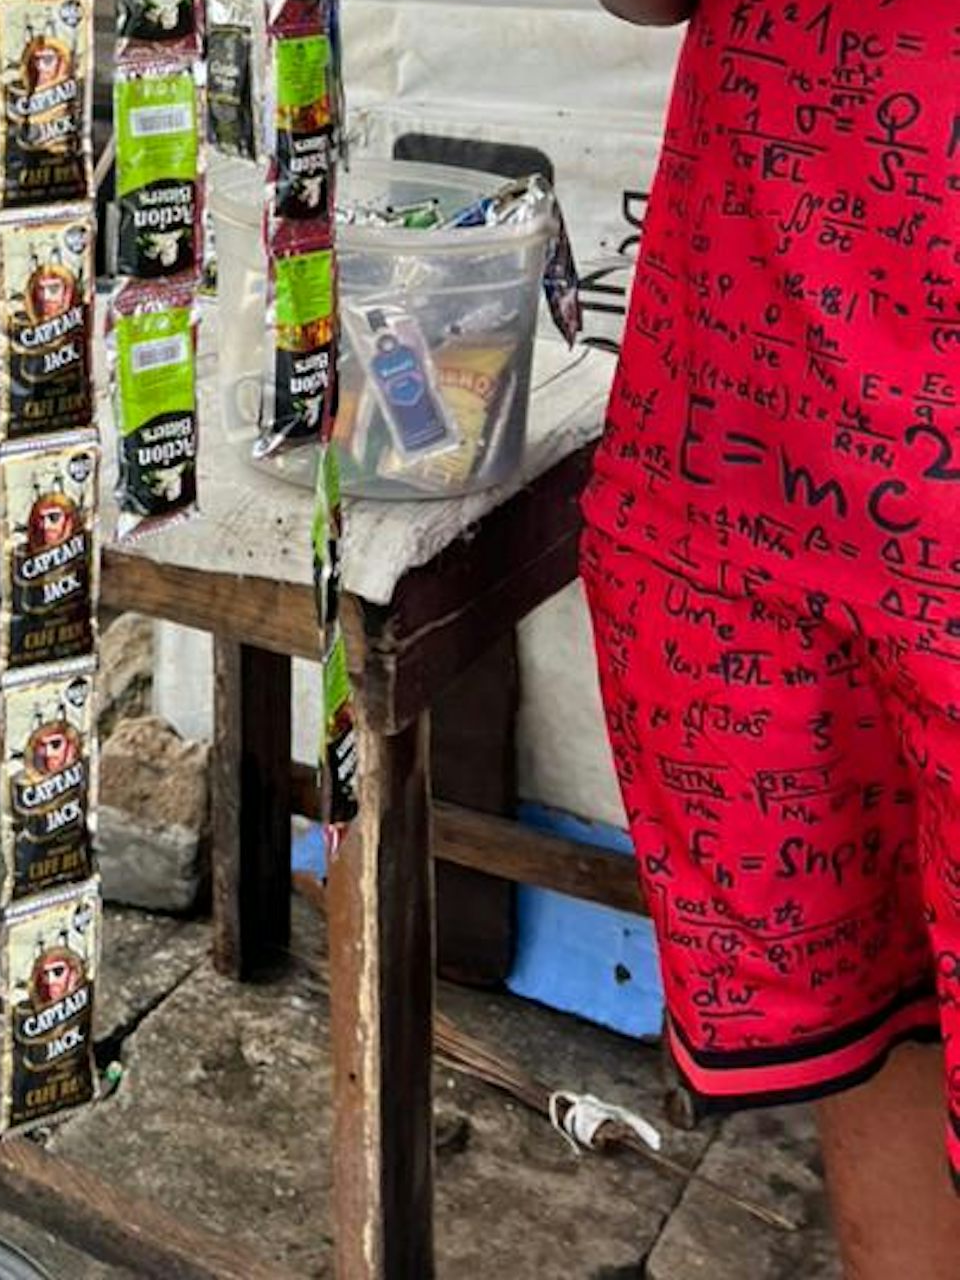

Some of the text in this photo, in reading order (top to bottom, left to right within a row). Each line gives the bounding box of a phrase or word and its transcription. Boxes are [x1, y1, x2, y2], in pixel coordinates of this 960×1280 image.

[40, 117, 77, 141] JACK
[43, 343, 80, 374] JACK
[140, 417, 192, 444] Bitters
[138, 435, 196, 467] Action
[43, 573, 82, 604] JACK
[46, 800, 82, 833] JACK
[47, 1025, 85, 1060] JACK
